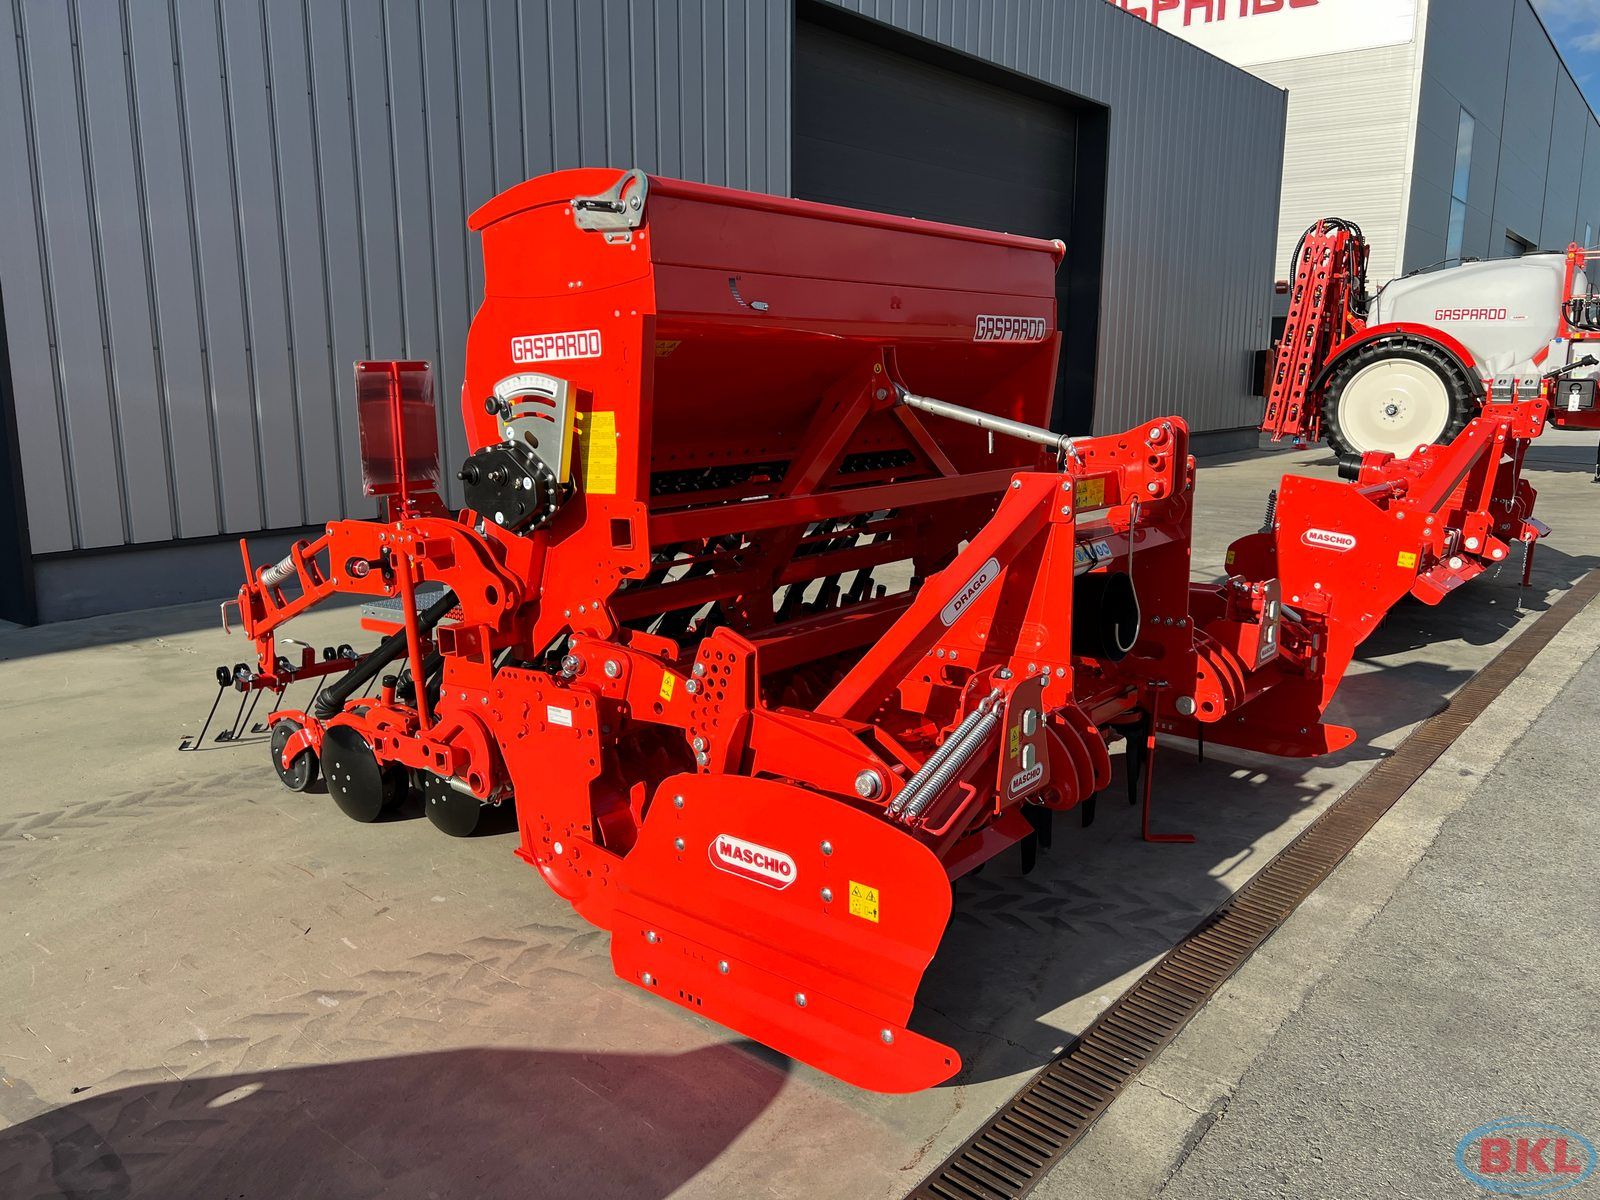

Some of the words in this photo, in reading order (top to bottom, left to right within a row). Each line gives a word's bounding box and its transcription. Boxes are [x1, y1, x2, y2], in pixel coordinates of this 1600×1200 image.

[1435, 309, 1506, 320] GASPARDO
[975, 317, 1044, 340] GASPARDO
[513, 332, 599, 361] GASPARDO
[1309, 532, 1352, 546] MASCHIO
[954, 574, 987, 611] DRAGO
[1013, 767, 1041, 789] MASCHIO
[720, 842, 791, 876] MASCHIO
